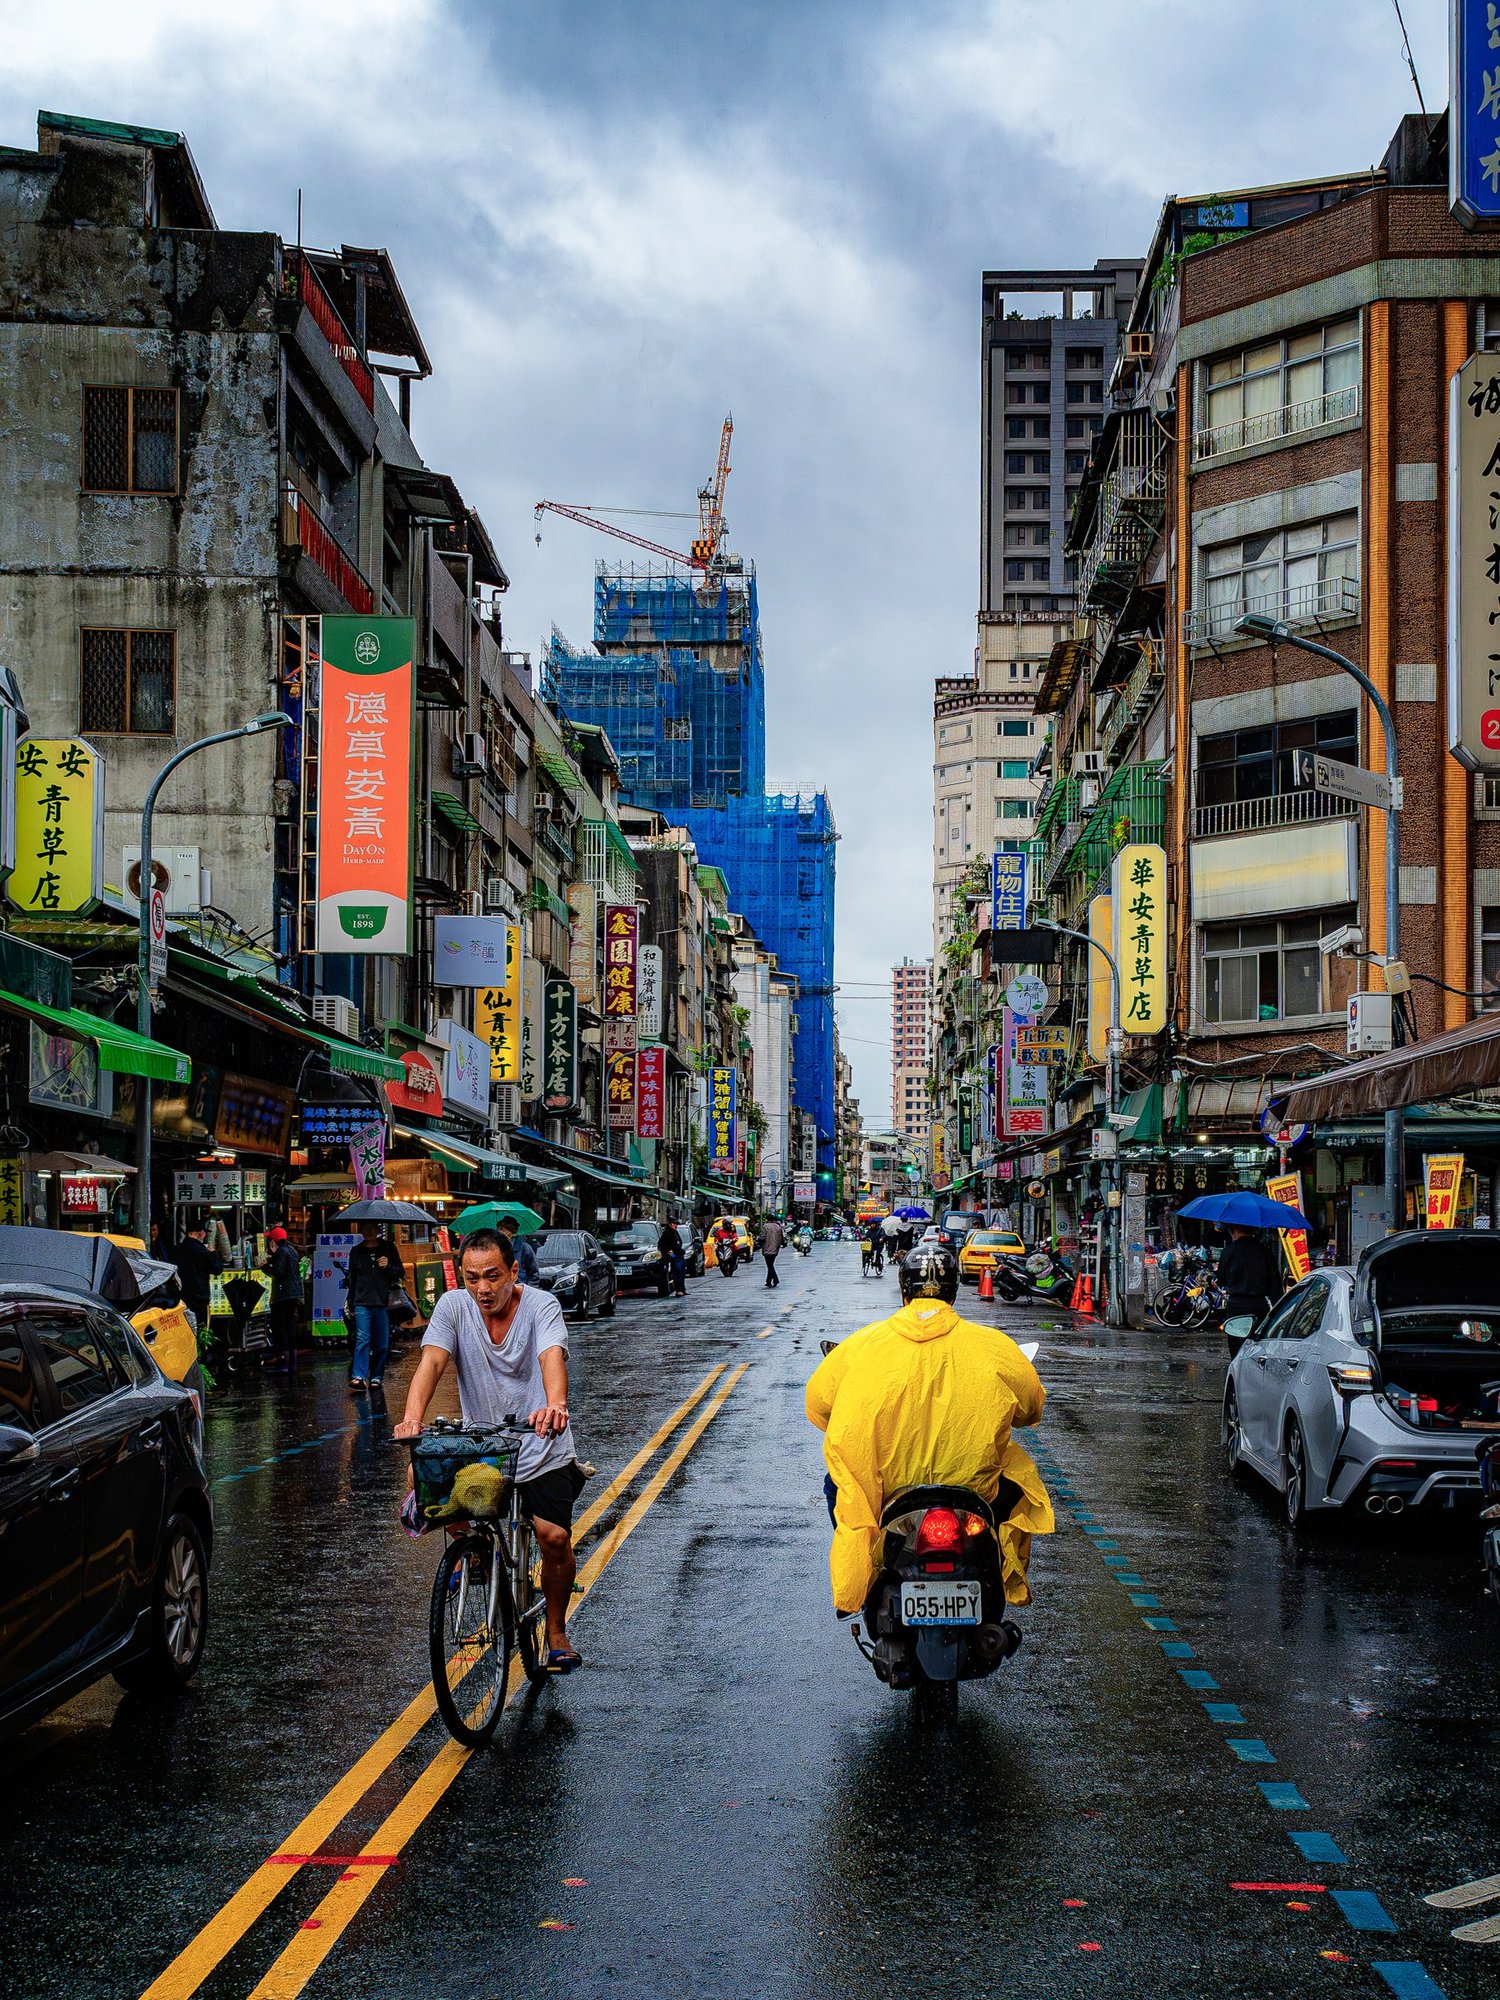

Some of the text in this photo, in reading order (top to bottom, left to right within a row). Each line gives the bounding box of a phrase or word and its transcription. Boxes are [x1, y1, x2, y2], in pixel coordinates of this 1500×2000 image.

[344, 691, 389, 839] 德草安青
[30, 785, 70, 909] 青草店
[352, 919, 374, 928] 1898
[607, 912, 635, 1014] 鑫園健康
[1127, 857, 1155, 1021] 華安青草店
[483, 990, 512, 1079] 仙青草行
[547, 984, 571, 1093] 十方茶居
[607, 1051, 634, 1101] 會館
[1009, 1110, 1043, 1132] 藥
[177, 1183, 239, 1200] 青草茶
[904, 1596, 979, 1618] 055-HPY
